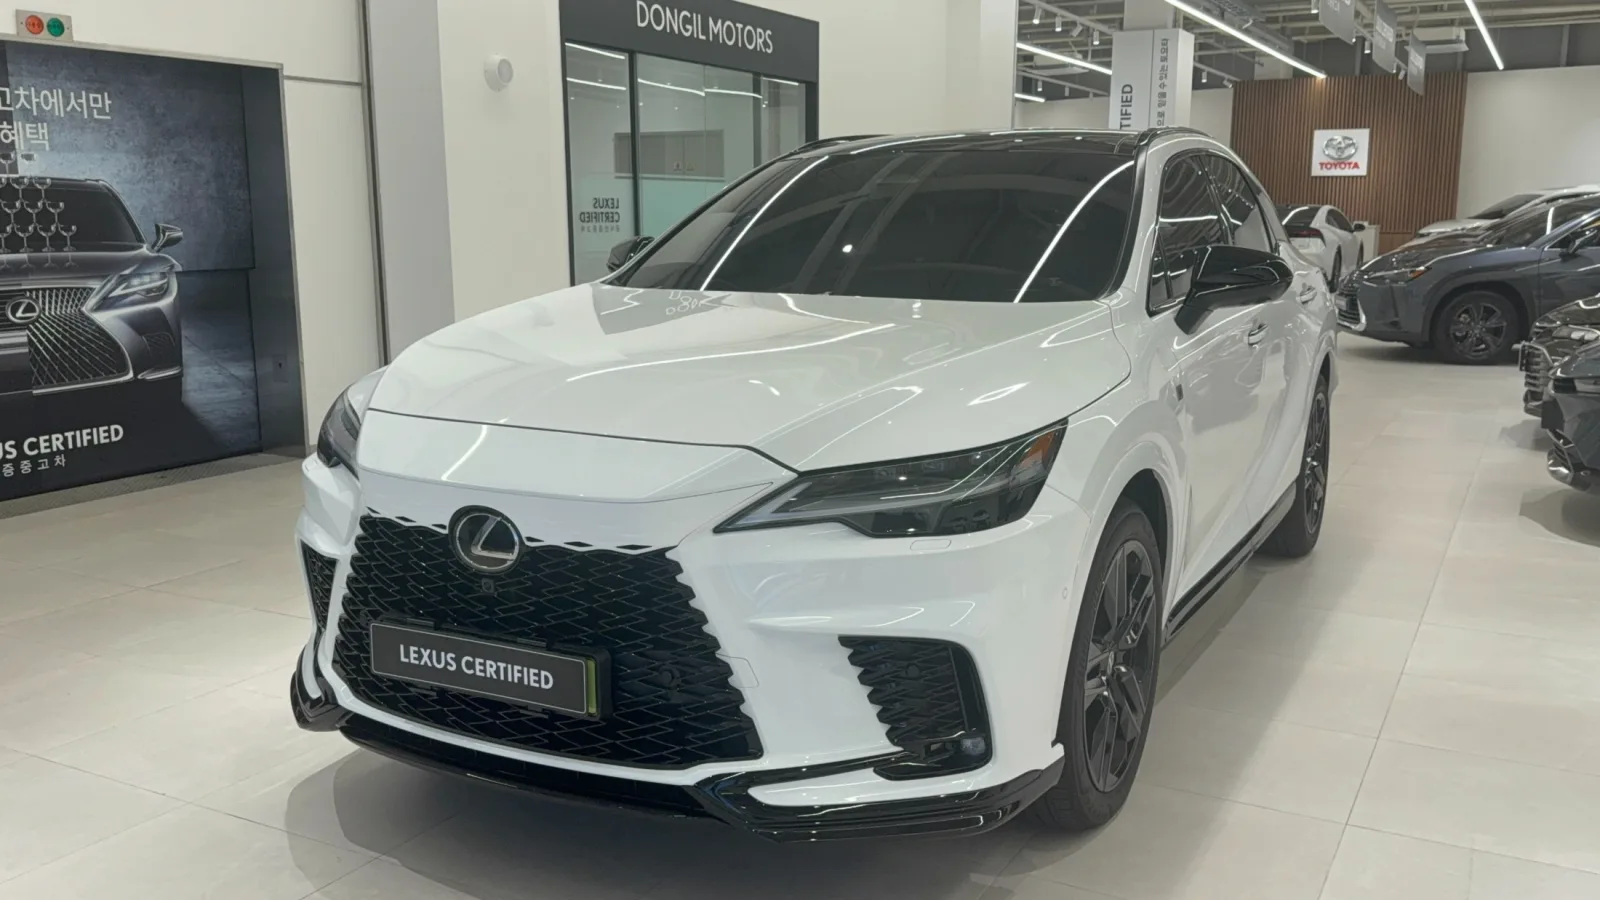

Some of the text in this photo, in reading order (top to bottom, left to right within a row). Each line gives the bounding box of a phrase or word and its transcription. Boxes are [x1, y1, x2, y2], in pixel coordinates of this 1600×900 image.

[636, 0, 773, 54] DONGIL MOTORS
[0, 121, 49, 151] 혜택
[1318, 161, 1360, 170] TOYOTA
[23, 424, 124, 456] CERTIFIED
[400, 644, 554, 689] LEXUS CERTIFIED
